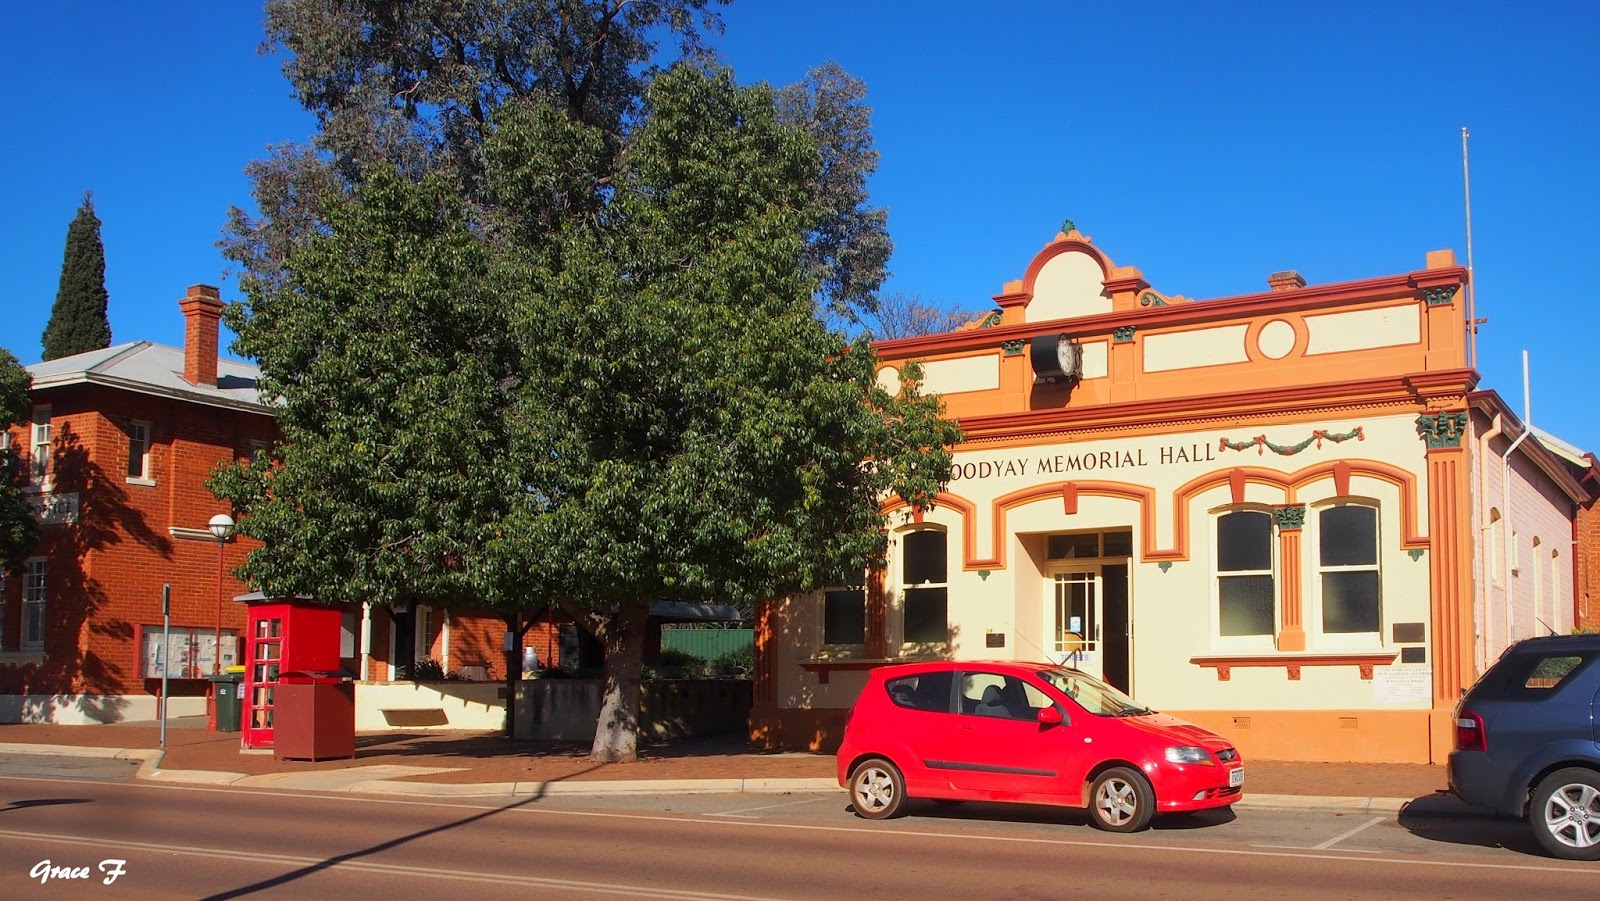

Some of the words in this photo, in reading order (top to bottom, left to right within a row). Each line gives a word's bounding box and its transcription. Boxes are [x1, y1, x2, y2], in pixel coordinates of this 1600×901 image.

[950, 458, 1029, 481] OODYAY
[1036, 448, 1148, 474] MEMORIAL
[1160, 443, 1215, 465] HALL
